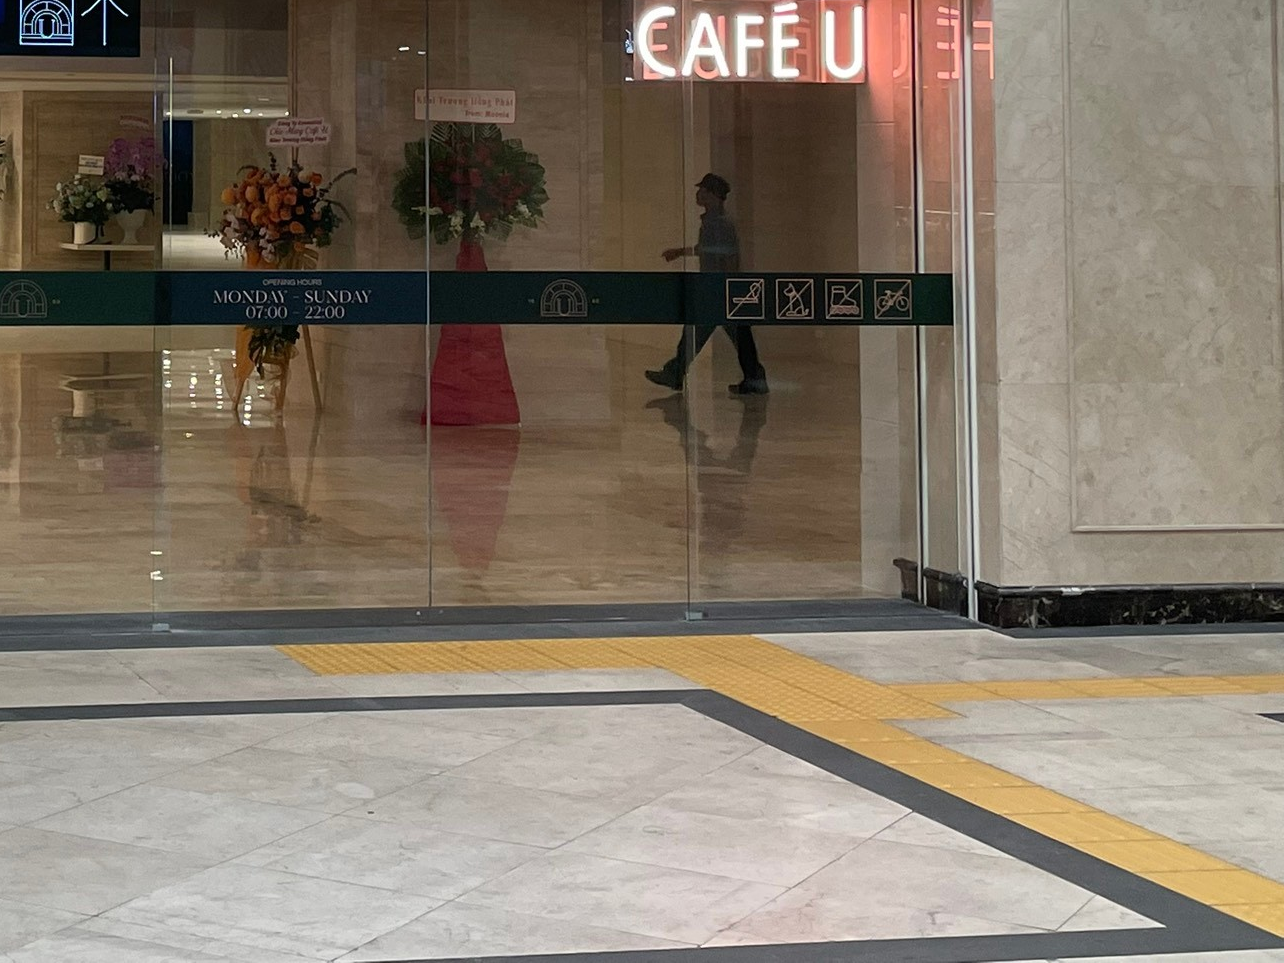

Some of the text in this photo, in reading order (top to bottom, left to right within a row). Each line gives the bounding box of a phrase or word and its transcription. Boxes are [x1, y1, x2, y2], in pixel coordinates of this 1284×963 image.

[637, 2, 800, 79] CAFÉ
[824, 5, 865, 79] U
[213, 289, 288, 304] MONDAY
[304, 289, 372, 304] SUNDAY
[245, 305, 288, 319] 07:00
[304, 305, 345, 319] 22:00
